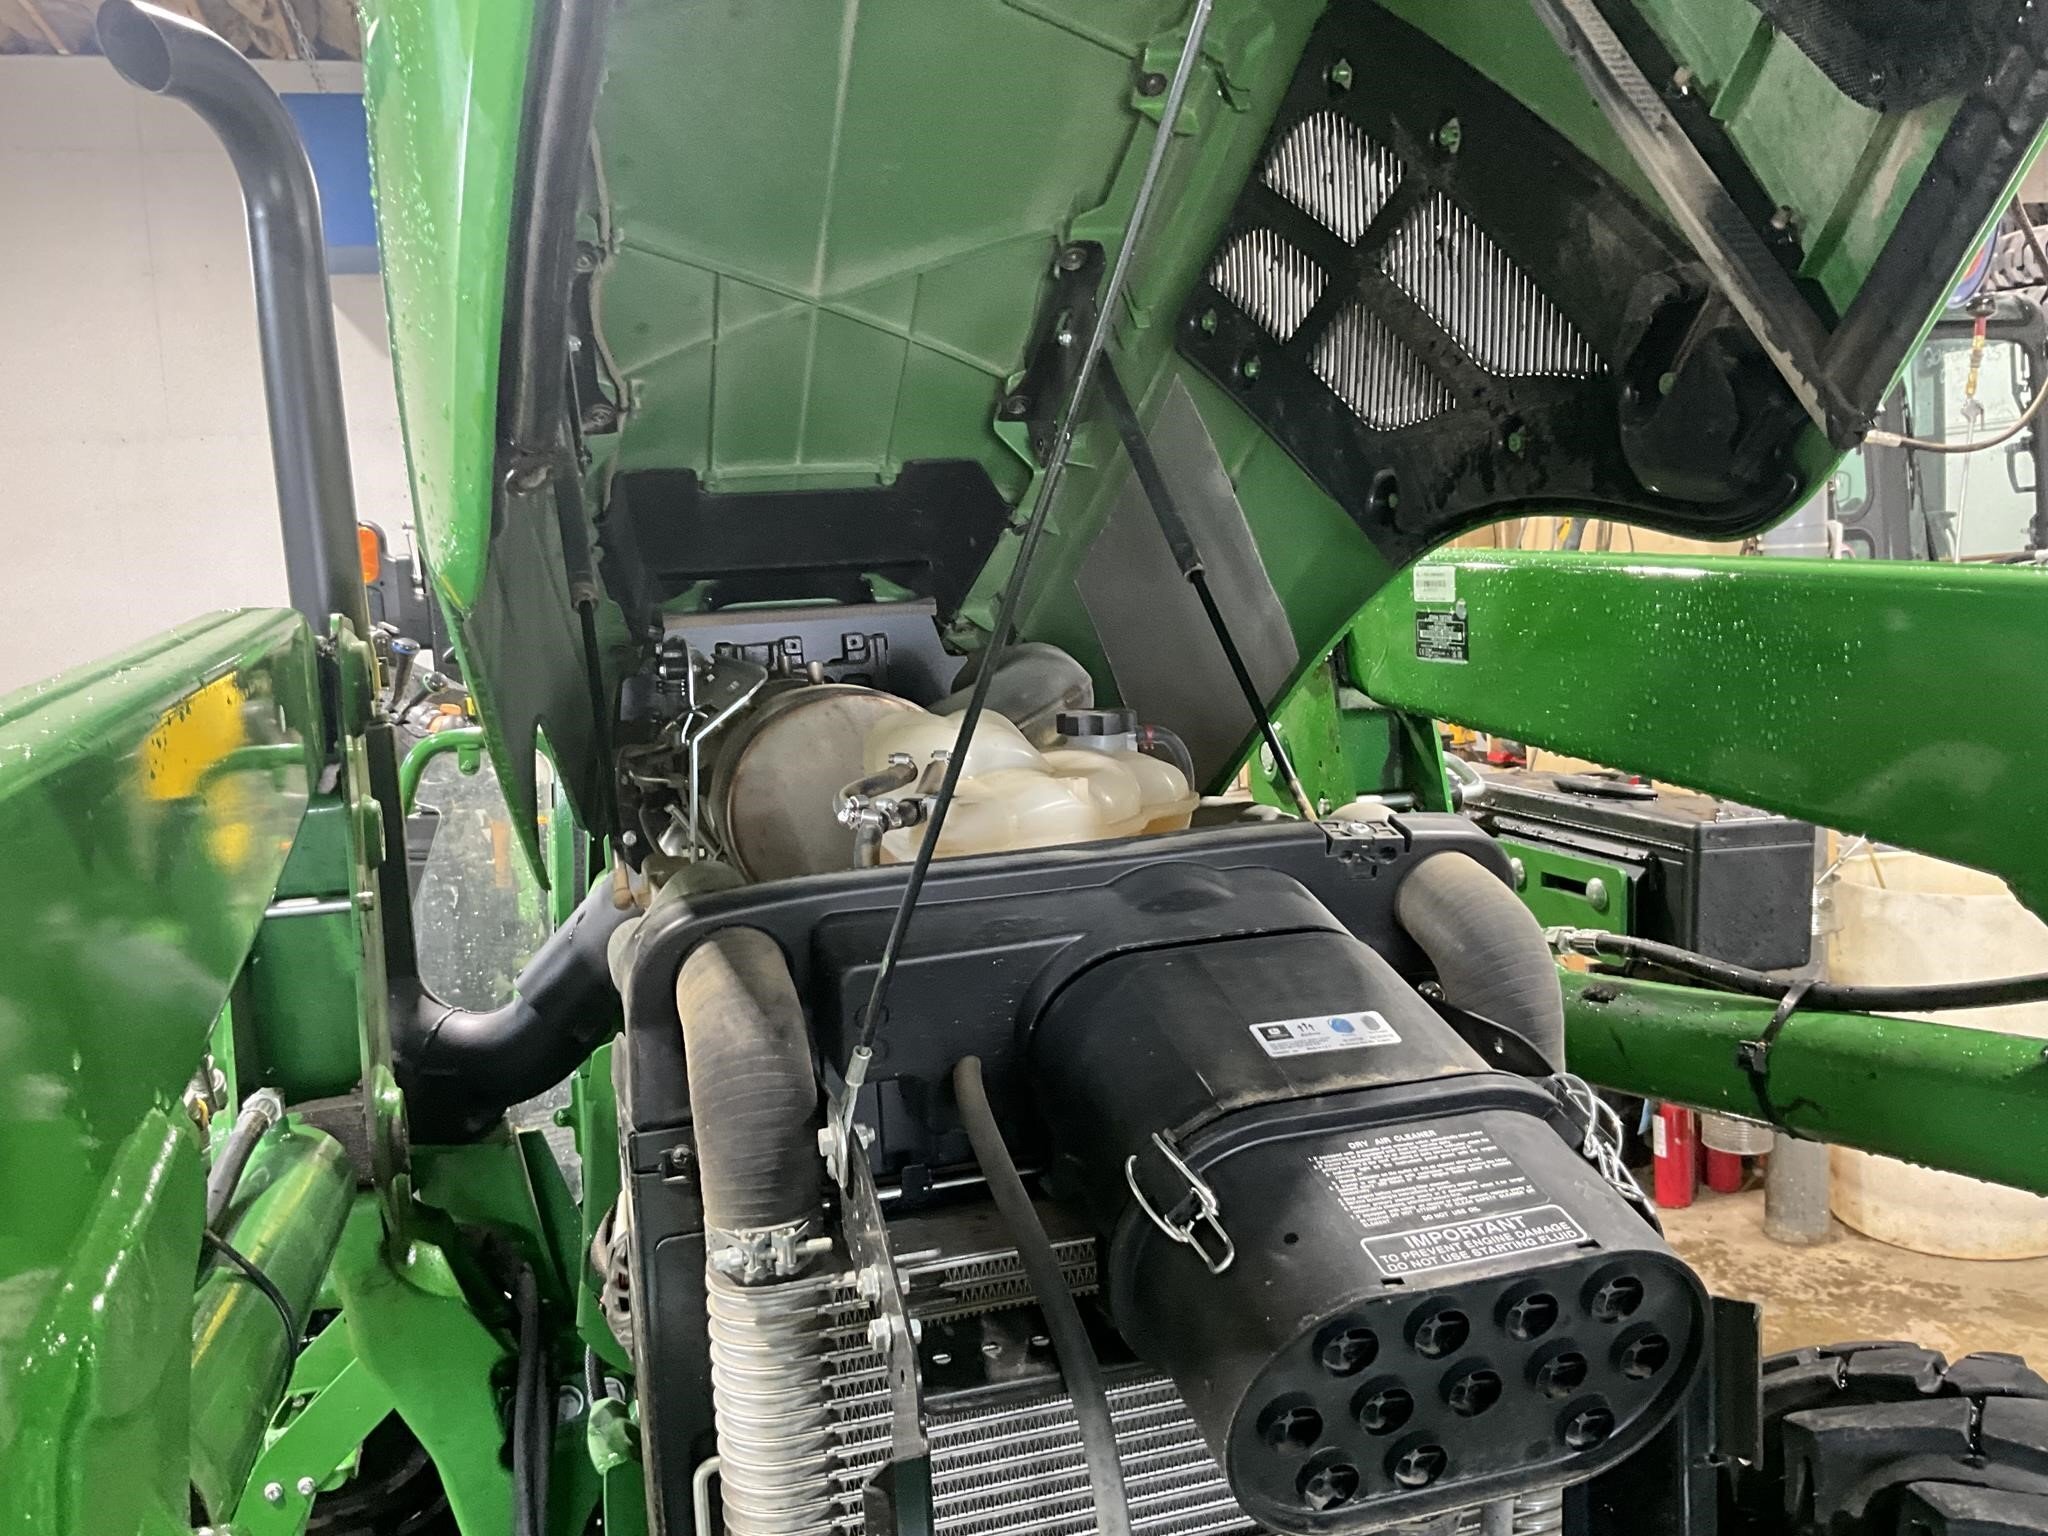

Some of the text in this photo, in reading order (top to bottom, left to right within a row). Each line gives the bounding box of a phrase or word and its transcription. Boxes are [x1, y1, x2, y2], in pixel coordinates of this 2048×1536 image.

[1348, 1129, 1437, 1150] DRY AIR CLEANER
[1379, 1221, 1570, 1265] TO PREVENT ENGINE DAMAGE
[1403, 1215, 1527, 1249] IMPORTANT
[1387, 1230, 1578, 1273] DO NOT USE STARTING FLUID
